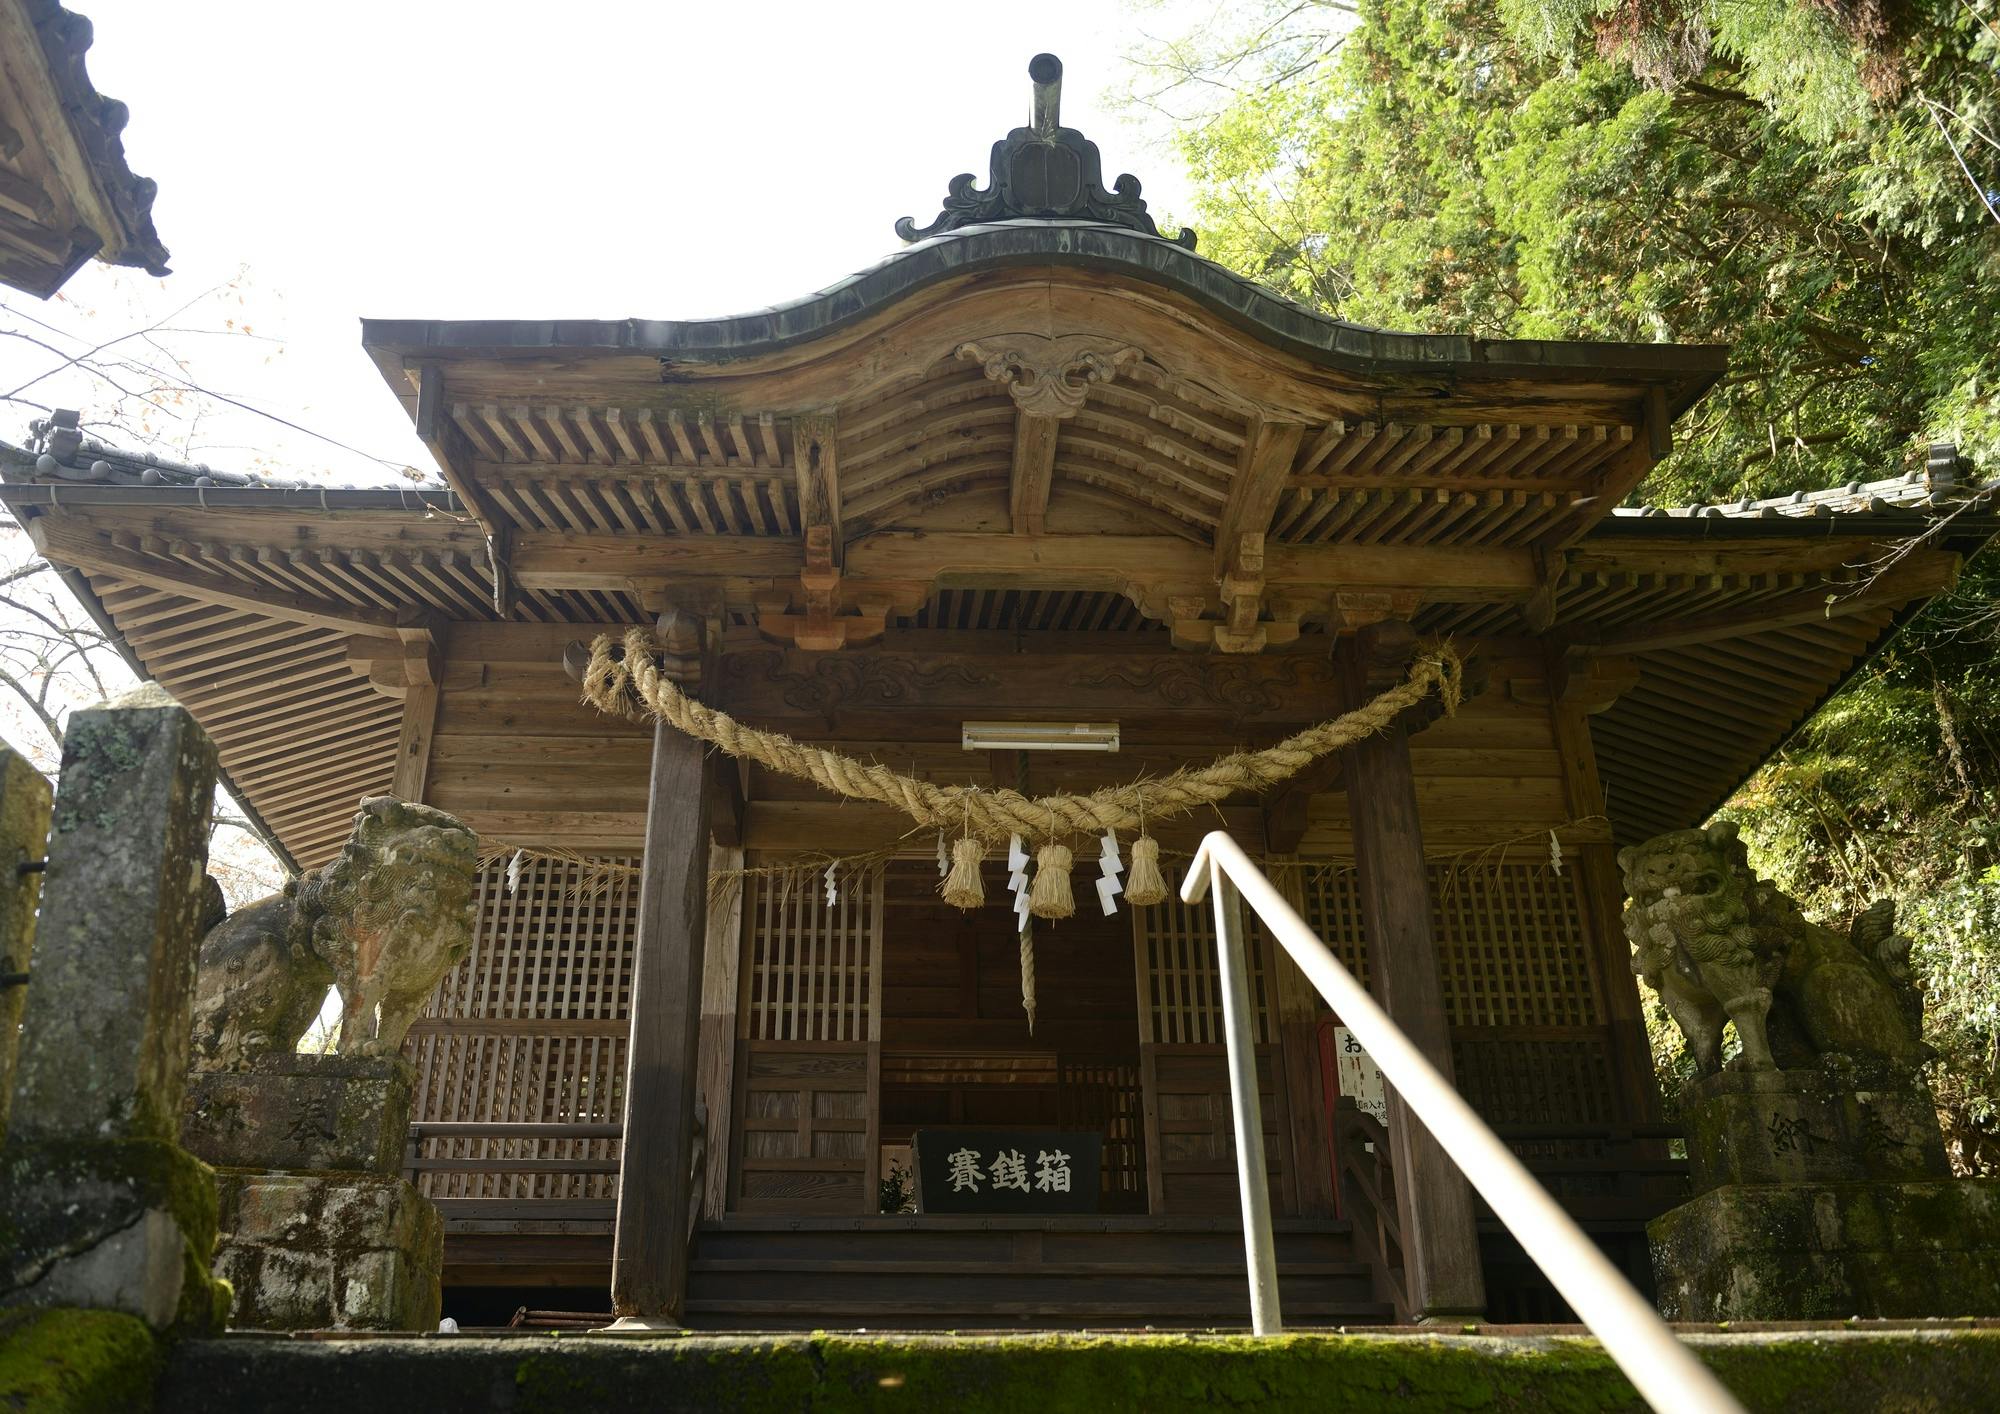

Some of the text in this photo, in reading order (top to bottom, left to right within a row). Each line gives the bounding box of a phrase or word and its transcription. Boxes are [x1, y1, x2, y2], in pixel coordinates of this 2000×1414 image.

[1344, 1033, 1366, 1054] お
[944, 1147, 1071, 1193] 賽銭箱
